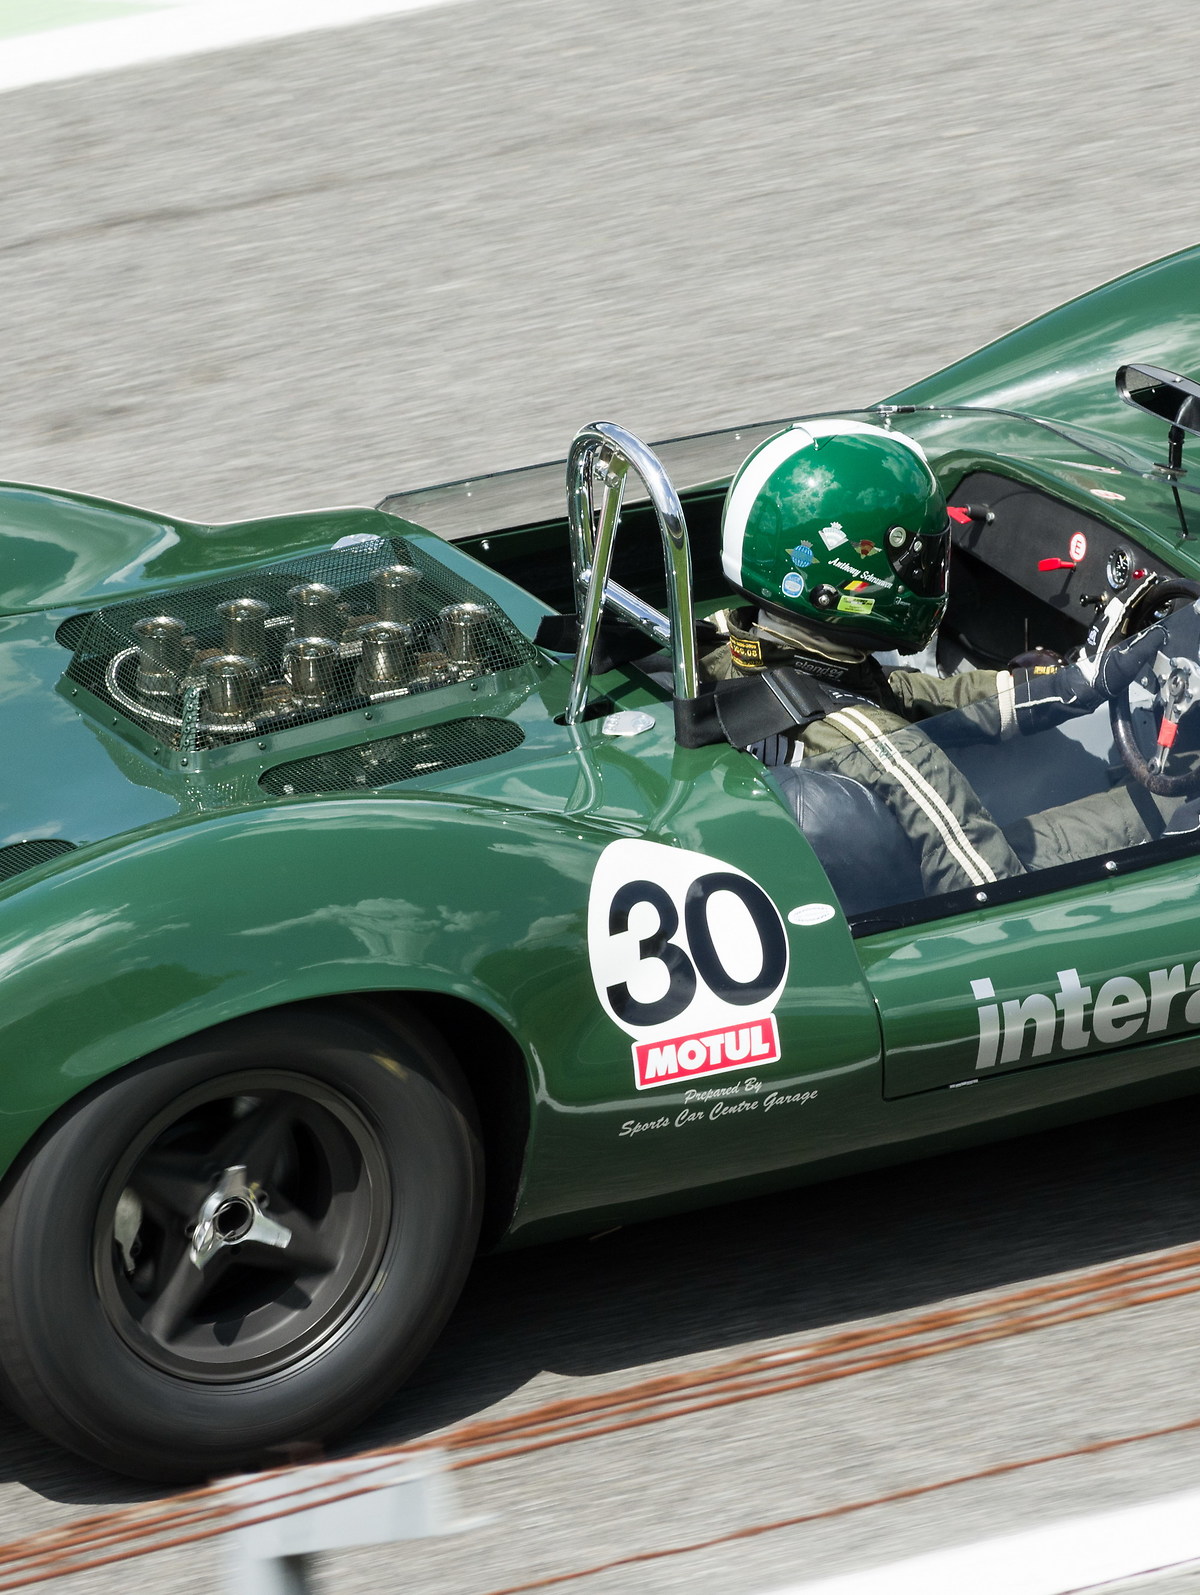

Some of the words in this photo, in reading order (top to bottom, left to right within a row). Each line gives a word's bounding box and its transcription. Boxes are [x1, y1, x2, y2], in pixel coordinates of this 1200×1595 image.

[828, 558, 861, 577] Anthony
[606, 872, 787, 1026] 30
[644, 1025, 770, 1080] MOTUL
[618, 1116, 670, 1137] Sports
[674, 1108, 704, 1128] Car
[708, 1101, 759, 1121] Centre
[763, 1090, 818, 1112] Garage
[684, 1081, 740, 1104] Prepared
[744, 1077, 763, 1093] By
